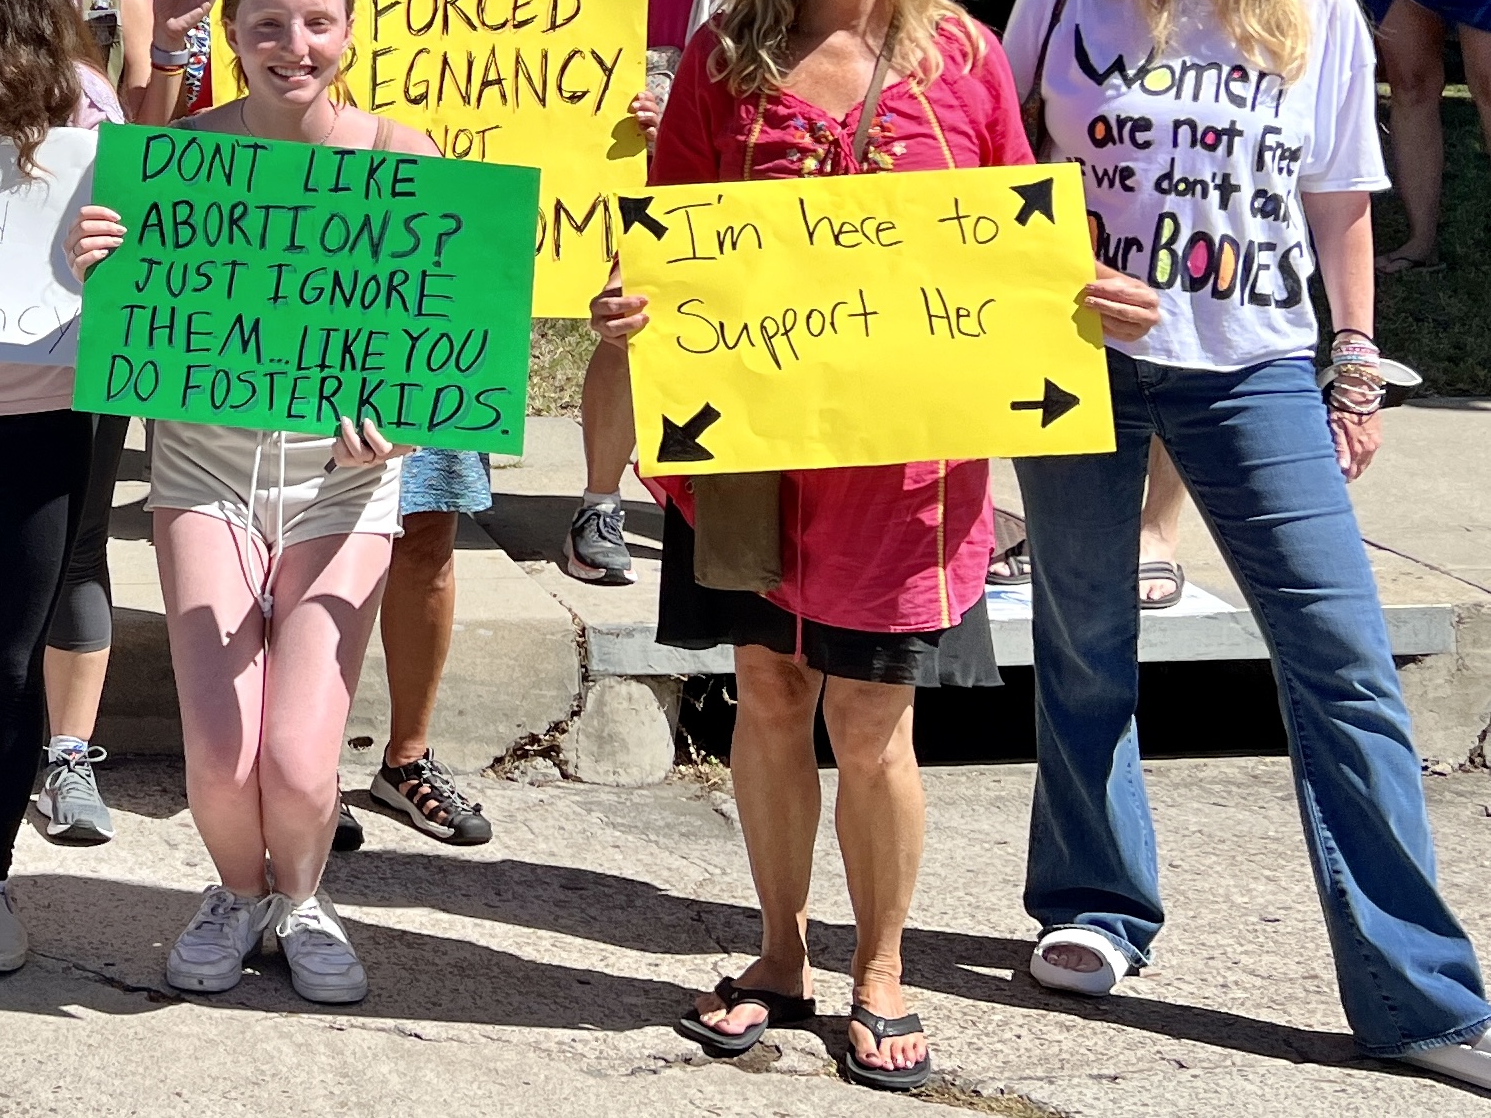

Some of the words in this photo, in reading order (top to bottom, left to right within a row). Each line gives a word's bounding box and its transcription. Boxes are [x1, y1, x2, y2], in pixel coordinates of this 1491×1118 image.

[1074, 23, 1285, 117] Women
[1088, 114, 1152, 149] are
[1173, 117, 1244, 157] not
[304, 147, 419, 200] LIKE
[1092, 163, 1136, 193] we
[1154, 157, 1240, 210] don't
[138, 200, 462, 268] ABORTIONS?
[664, 194, 762, 264] I'm
[799, 197, 904, 248] here
[938, 197, 999, 245] to
[1148, 211, 1304, 309] BODIES
[134, 258, 250, 299] JUST
[268, 261, 456, 322] IGNORE
[296, 328, 389, 375] LIKE
[405, 327, 489, 375] YOU
[676, 288, 879, 370] Support
[920, 286, 996, 339] Her
[106, 354, 159, 402] DO
[181, 364, 343, 422] FOSTER
[357, 377, 511, 436] KIDS.
